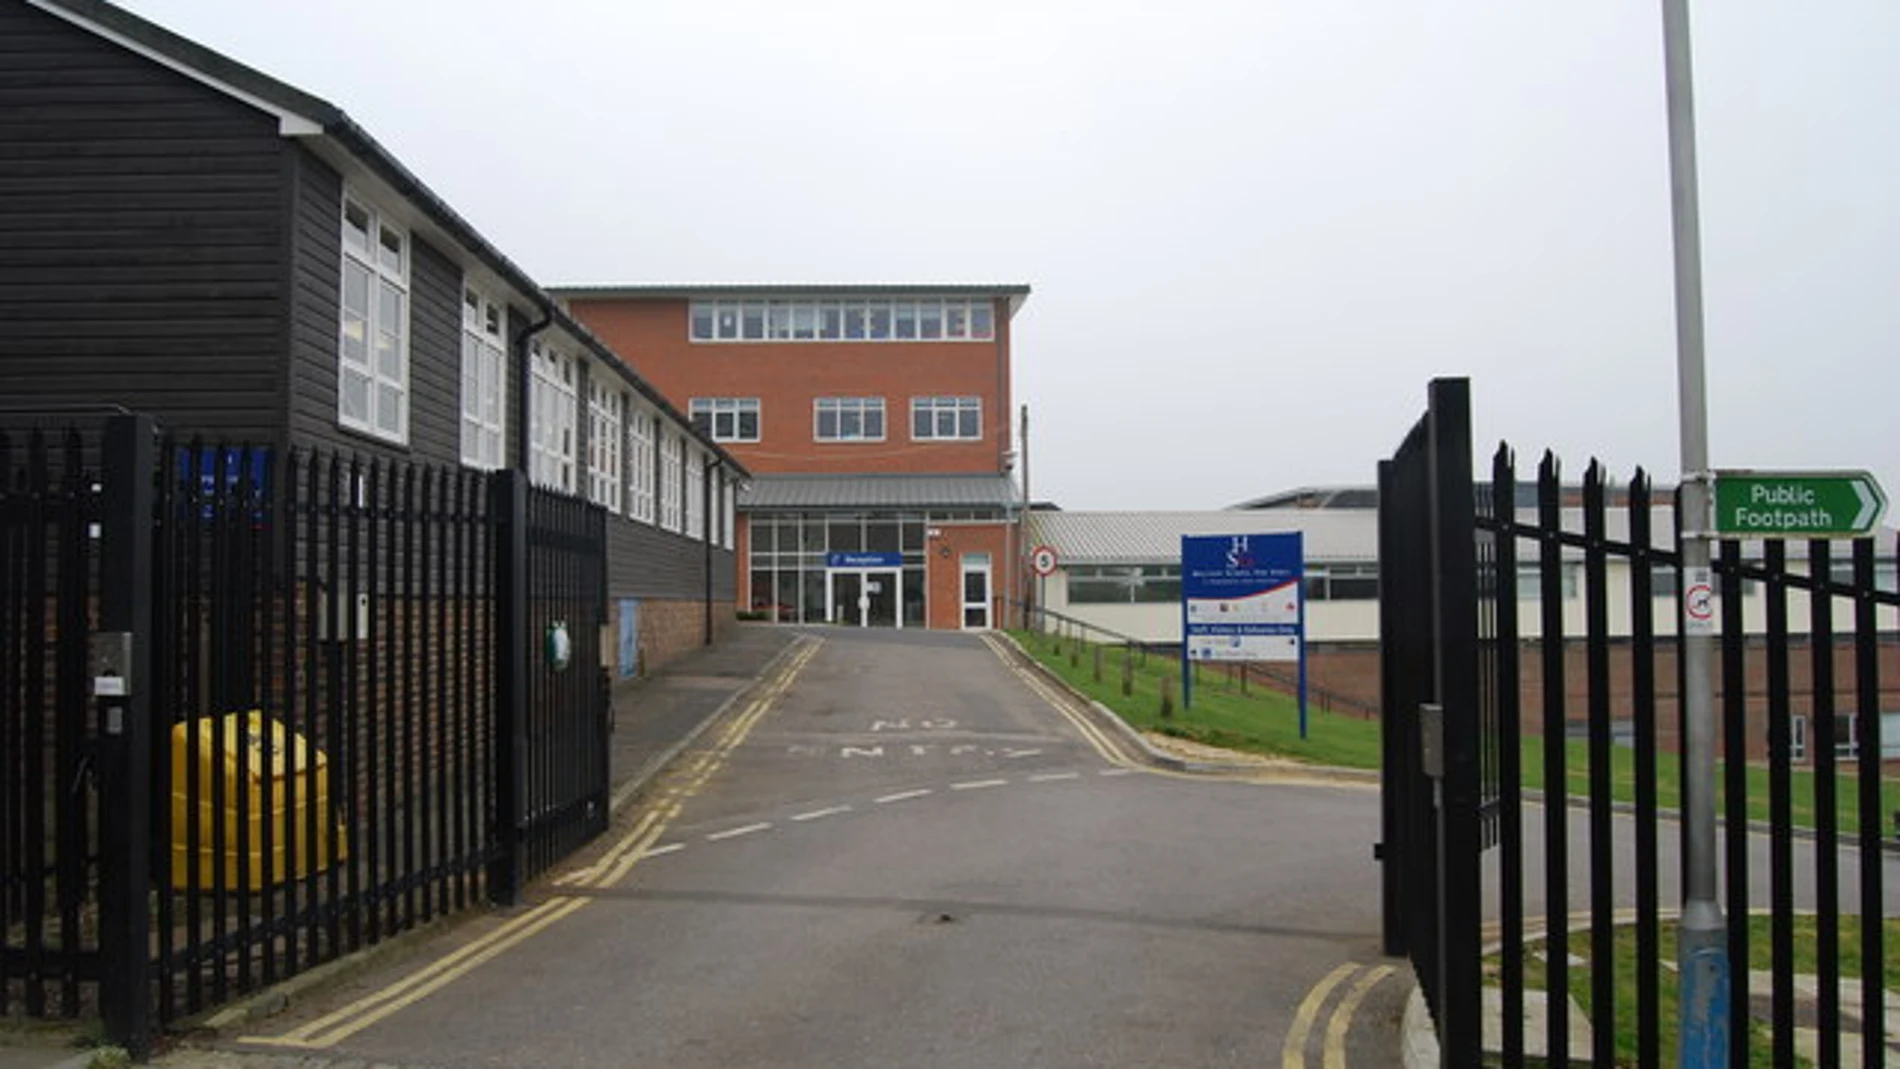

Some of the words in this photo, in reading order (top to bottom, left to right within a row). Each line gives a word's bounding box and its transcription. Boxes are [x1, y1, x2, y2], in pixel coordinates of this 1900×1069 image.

[1750, 484, 1815, 504] Public
[1735, 507, 1832, 529] Footpath
[845, 556, 885, 565] Reception
[1040, 554, 1049, 568] 5
[870, 718, 959, 732] NO
